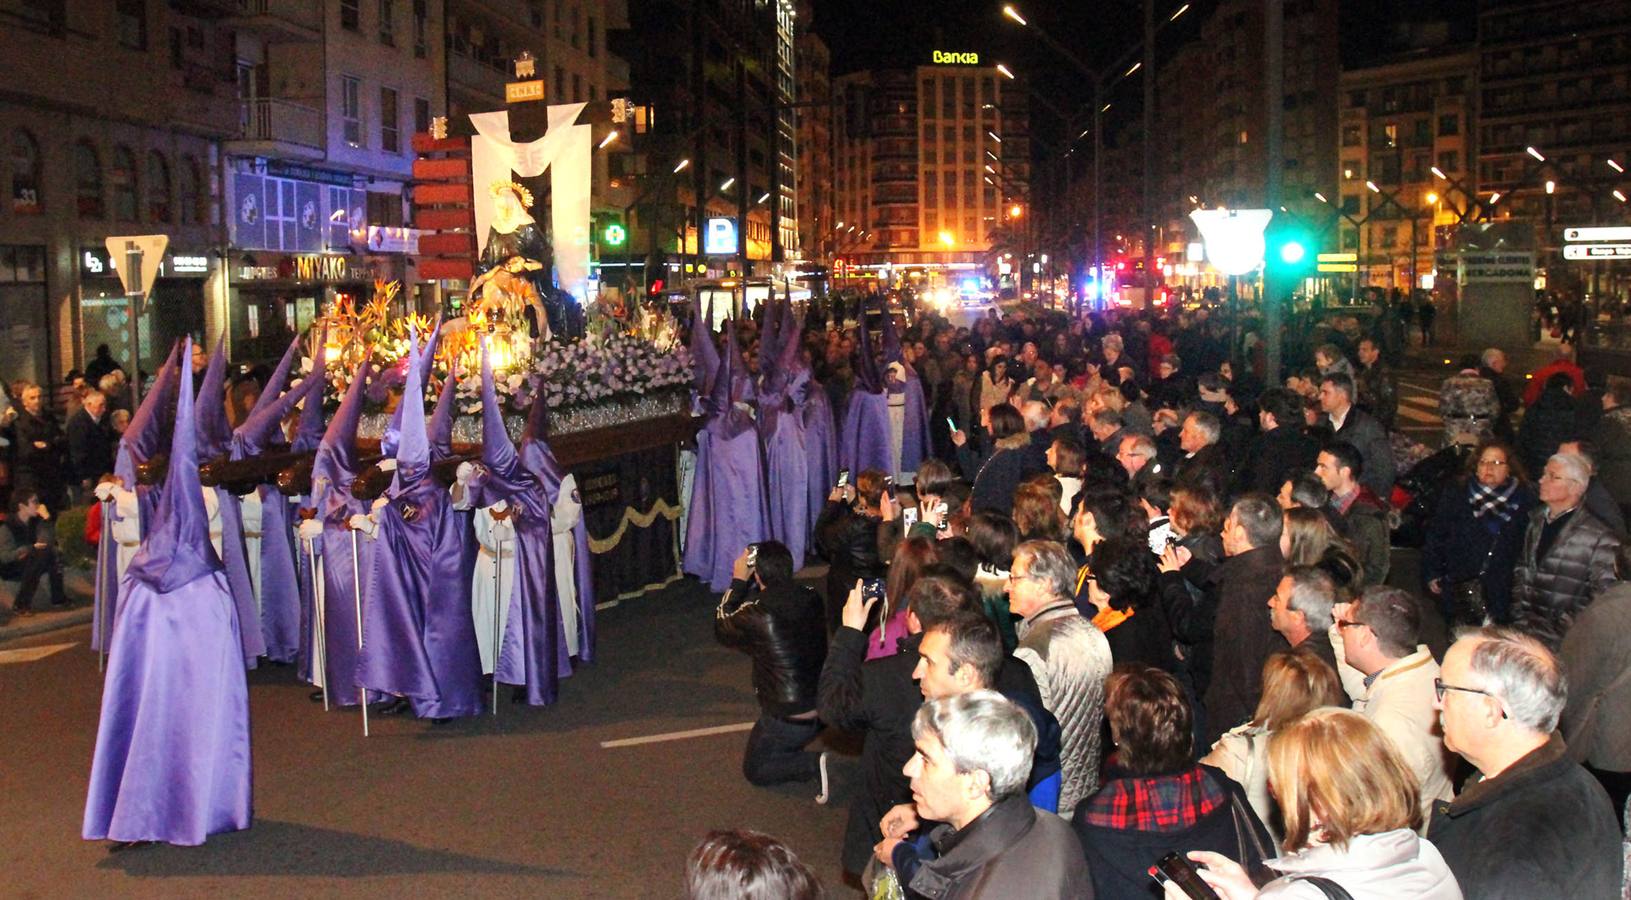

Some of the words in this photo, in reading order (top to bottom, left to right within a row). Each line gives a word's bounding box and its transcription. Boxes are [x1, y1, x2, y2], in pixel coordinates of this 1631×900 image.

[933, 50, 979, 64] Bankia
[708, 218, 733, 245] P
[297, 256, 346, 280] MIYAKO
[1465, 268, 1532, 278] MERCADONA
